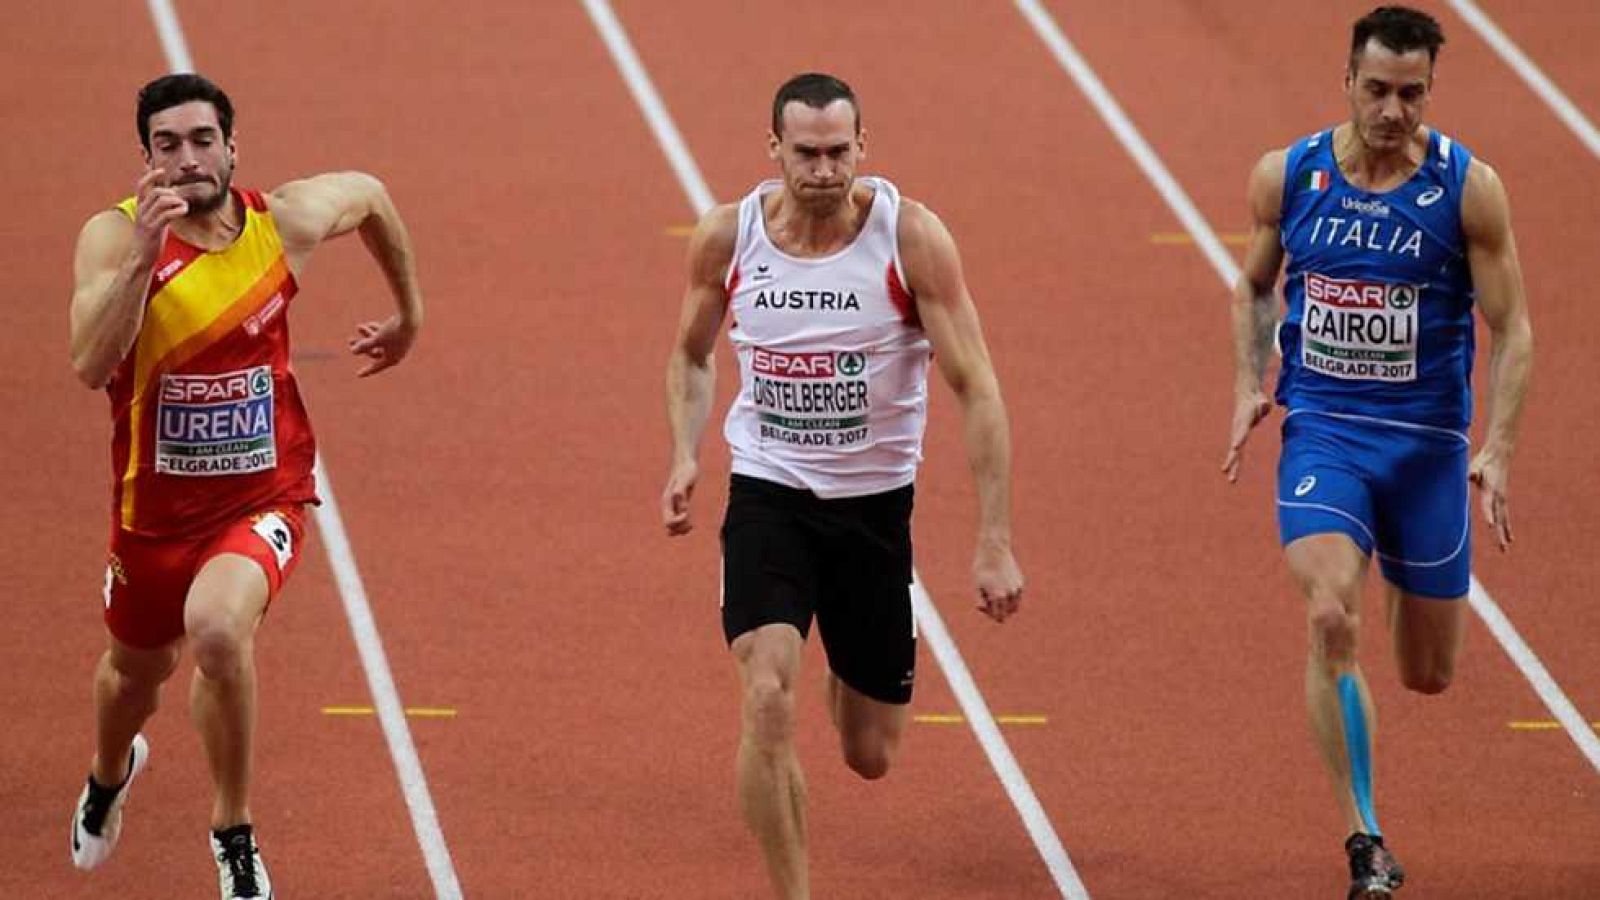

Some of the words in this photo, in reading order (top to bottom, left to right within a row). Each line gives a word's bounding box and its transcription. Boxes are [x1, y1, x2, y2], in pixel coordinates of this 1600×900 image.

[1310, 216, 1422, 257] ITALIA
[754, 291, 860, 311] AUSTRIA
[1309, 278, 1383, 306] SPAR
[1307, 304, 1412, 345] CAIROLI
[755, 350, 832, 374] SPAR
[1305, 352, 1379, 375] BELGRADE
[1381, 363, 1412, 377] 2017
[164, 376, 246, 401] SPAR
[754, 376, 869, 412] DISTELBERGER
[164, 402, 269, 440] UREÑA
[761, 424, 834, 446] BELGRADE
[838, 427, 868, 445] 2017
